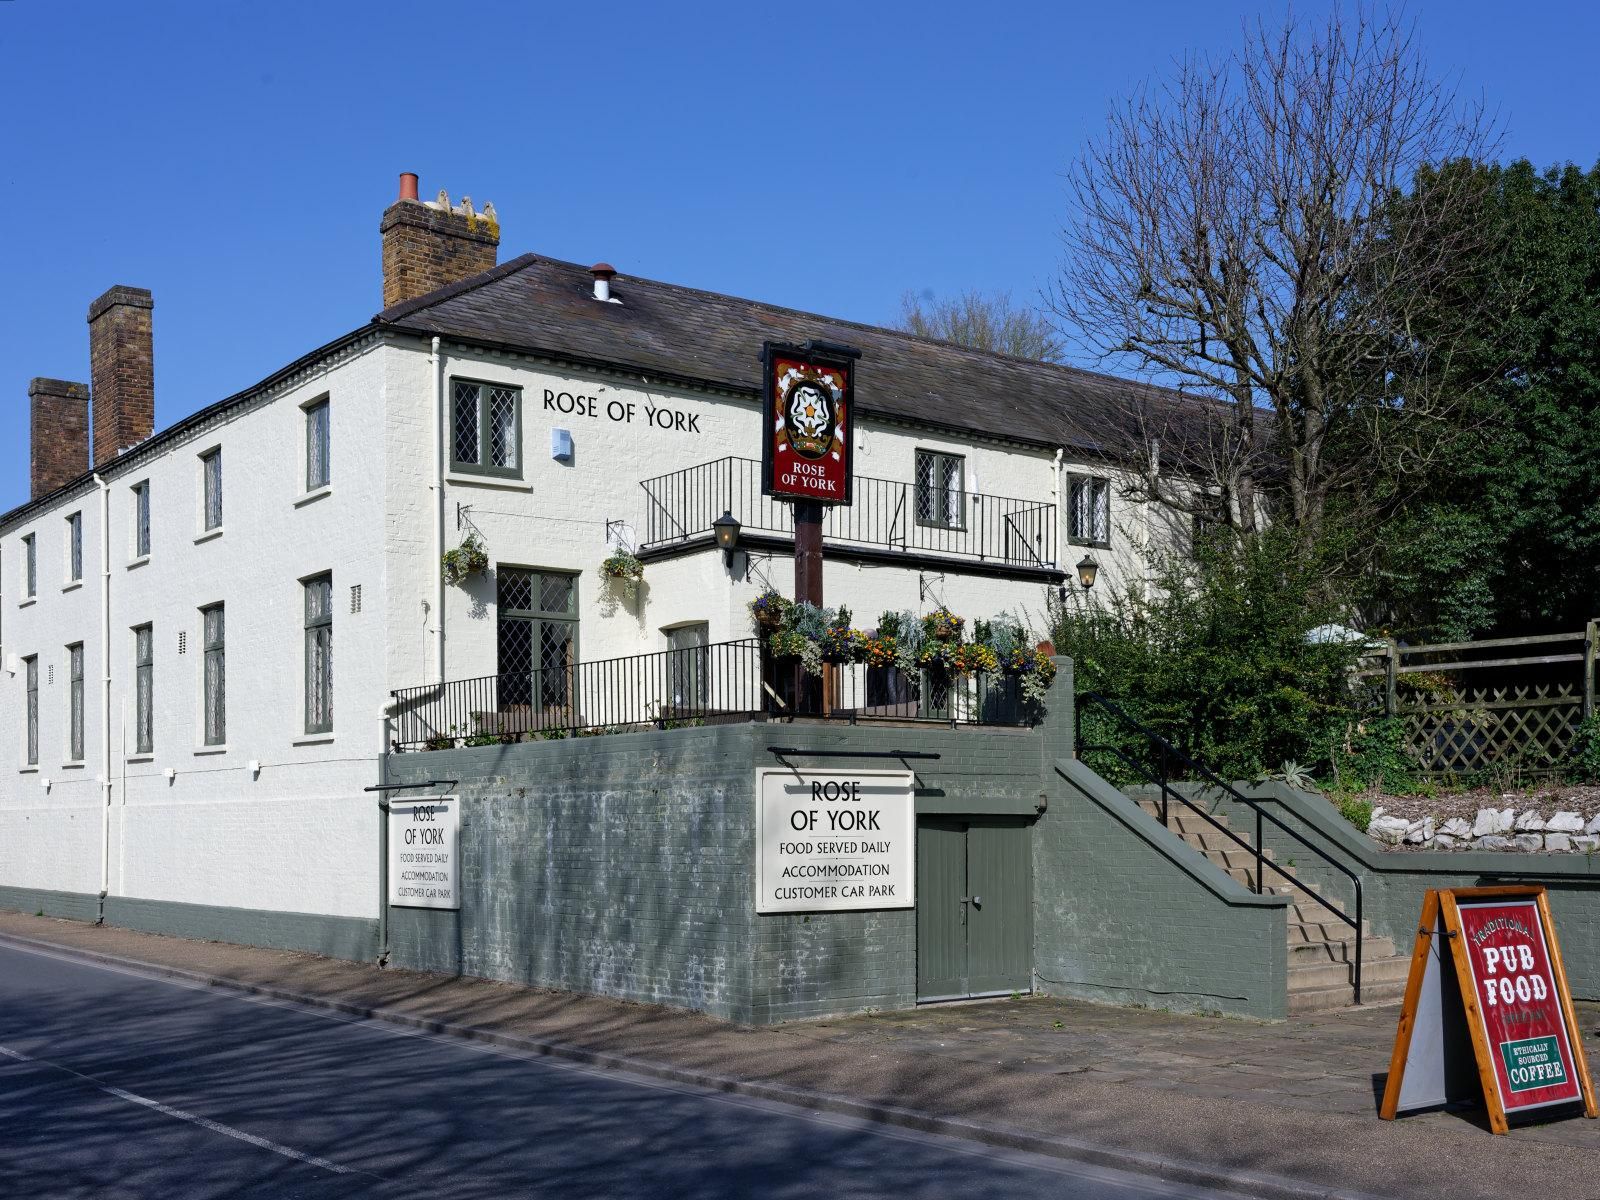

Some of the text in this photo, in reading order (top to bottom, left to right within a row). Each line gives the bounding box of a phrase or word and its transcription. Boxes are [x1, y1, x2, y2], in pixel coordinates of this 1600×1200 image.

[544, 389, 700, 433] ROSE OF YORK
[793, 462, 825, 477] ROSE
[781, 473, 836, 491] OF YORK
[811, 781, 861, 801] ROSE
[413, 805, 435, 821] ROSE
[791, 810, 880, 831] OF YORK
[404, 828, 444, 845] OF YORK
[780, 842, 891, 854] FOOD SERVED DAILY
[400, 853, 449, 863] FOOD SERVED DAILY
[401, 871, 448, 882] ACCOMMODATION
[782, 864, 890, 877] ACCOMMODATION
[398, 887, 451, 898] CUSTOMER CAR PARK
[774, 885, 895, 899] CUSTOMER CAR PARK
[1482, 944, 1534, 974] PUB
[1483, 974, 1547, 1006] FOOD
[1513, 1043, 1549, 1056] ETHICALLY
[1518, 1054, 1549, 1065] SOURCED
[1511, 1061, 1563, 1085] COFFEE
